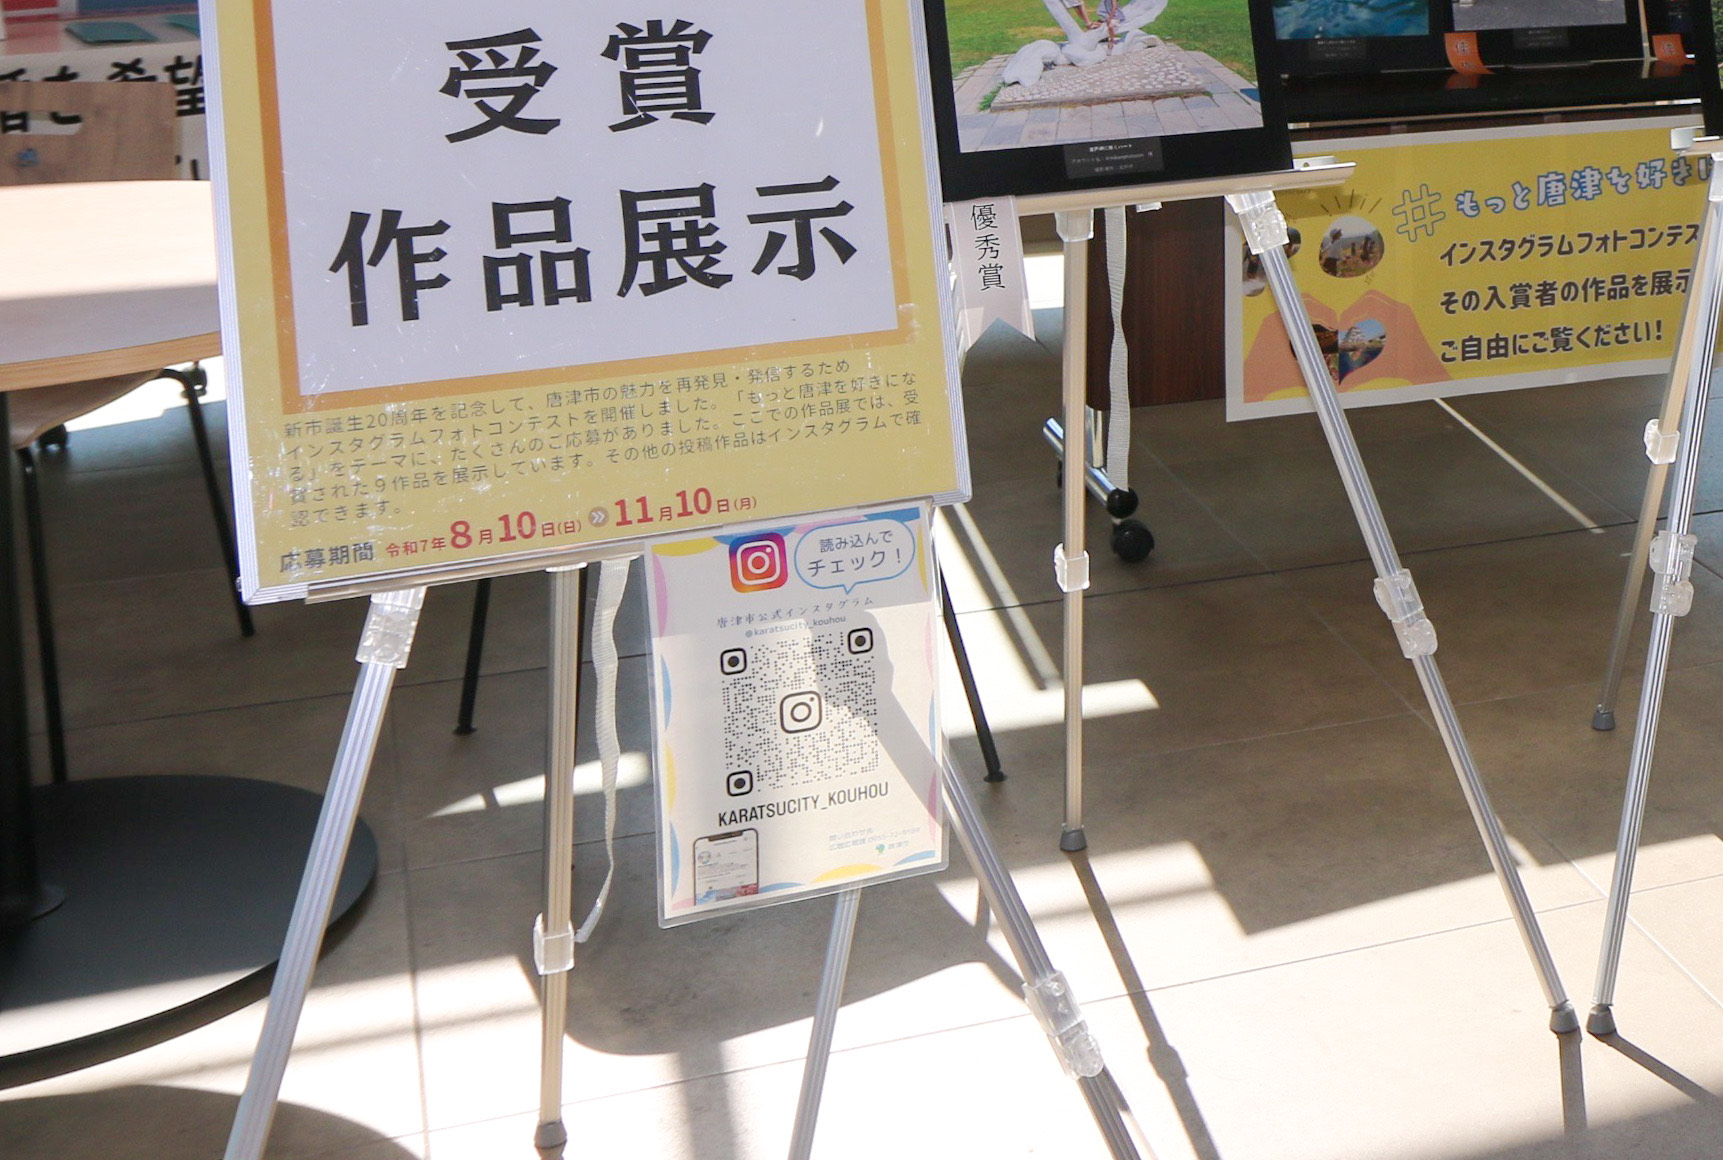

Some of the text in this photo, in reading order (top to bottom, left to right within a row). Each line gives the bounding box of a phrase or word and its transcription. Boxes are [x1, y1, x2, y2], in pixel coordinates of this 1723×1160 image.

[328, 174, 858, 327] 作品展示
[970, 203, 1006, 291] 優秀賞
[1439, 320, 1662, 365] ご自由にご覧ください!
[819, 529, 893, 553] 読み込んで
[279, 542, 375, 574] 応募期間
[807, 548, 902, 577] チェック！
[716, 596, 874, 629] 唐津市公式インスタグラム
[744, 615, 847, 638] @karatsucity_kouhou
[718, 782, 890, 827] KARATSUCITY_KOUHOU
